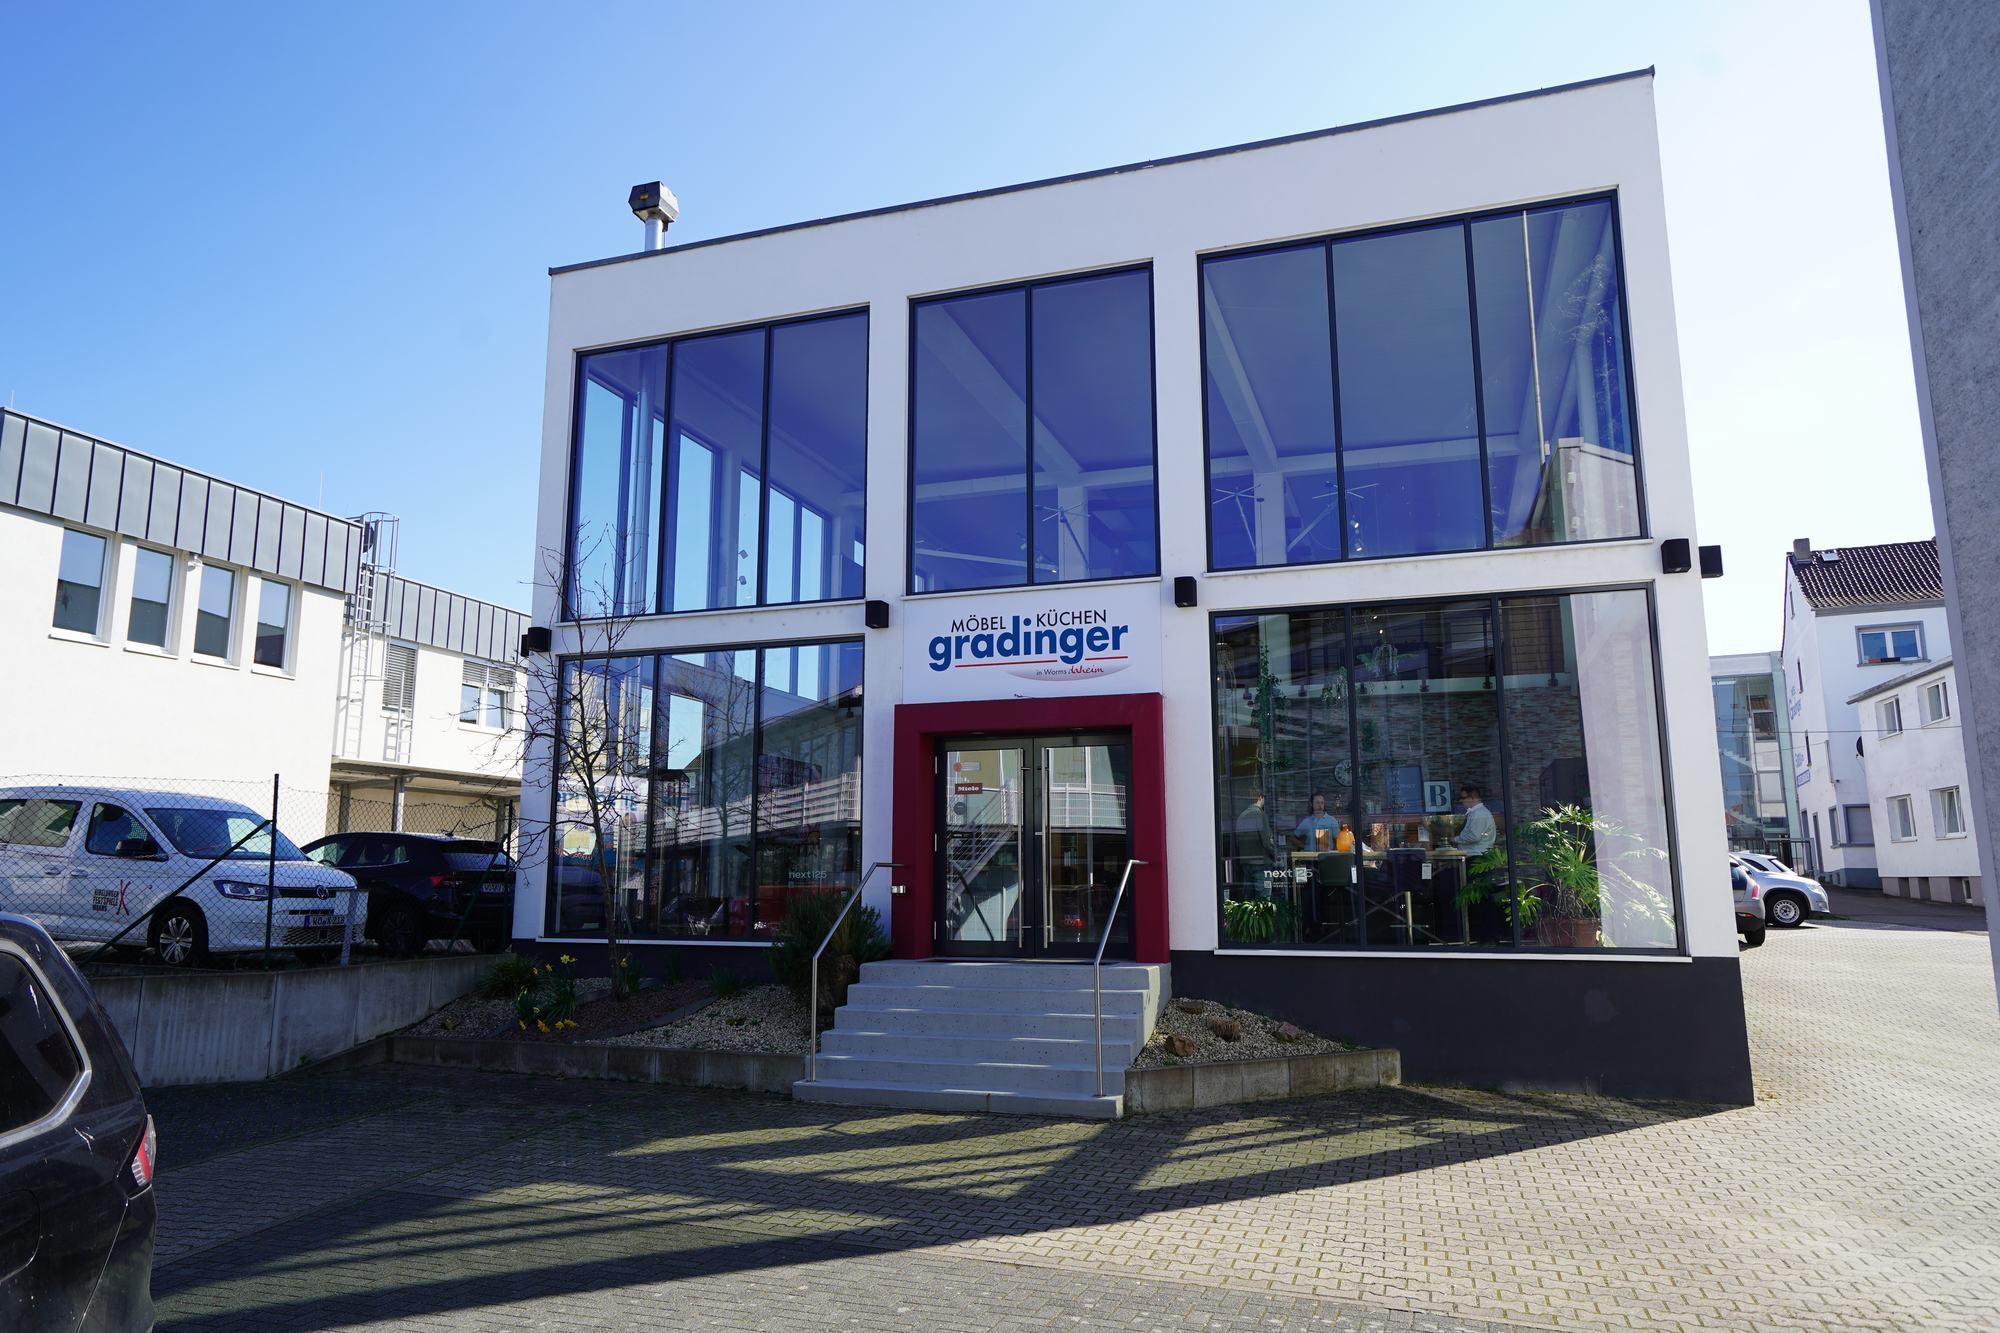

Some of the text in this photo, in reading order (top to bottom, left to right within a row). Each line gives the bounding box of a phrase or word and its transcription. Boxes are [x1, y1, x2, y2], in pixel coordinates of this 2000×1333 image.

[951, 608, 1107, 633] MÖBEL KÜCHEN
[928, 615, 1129, 672] gradinger
[1044, 668, 1067, 677] Worms
[1068, 664, 1105, 675] daheim
[1429, 784, 1448, 807] B
